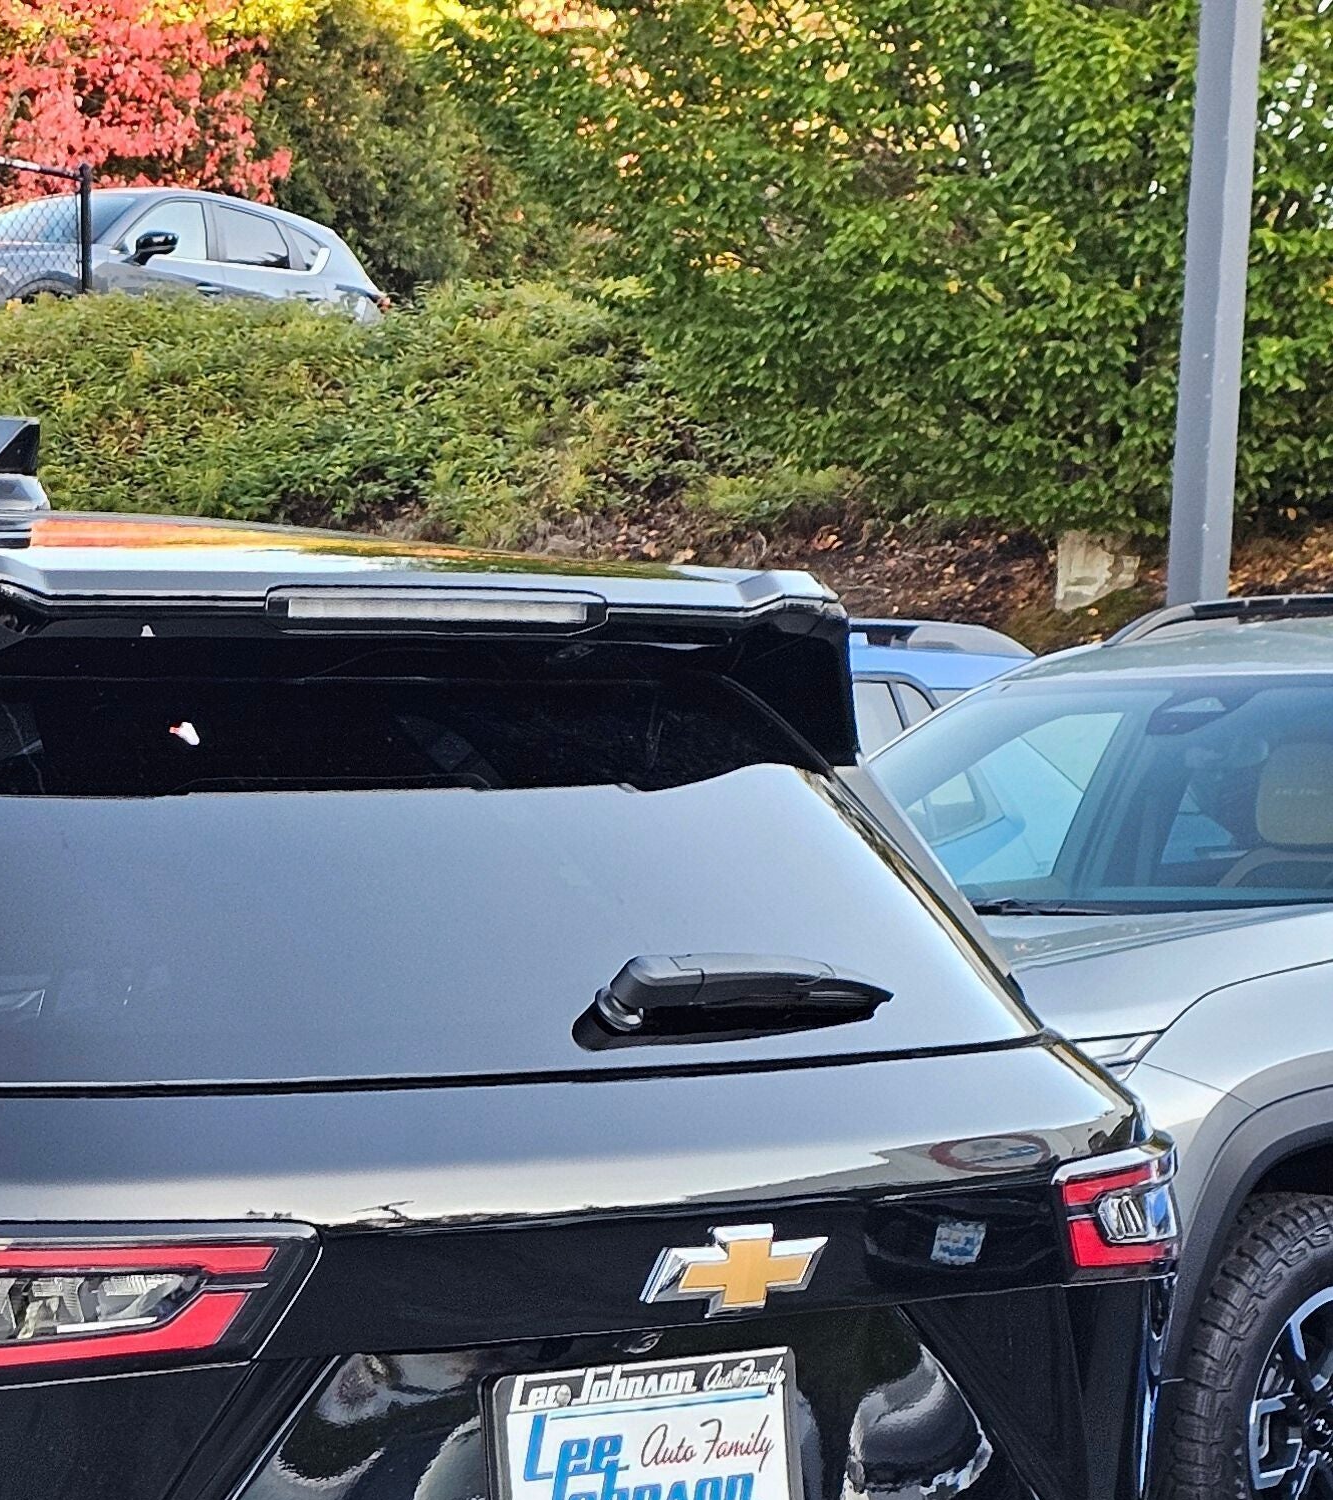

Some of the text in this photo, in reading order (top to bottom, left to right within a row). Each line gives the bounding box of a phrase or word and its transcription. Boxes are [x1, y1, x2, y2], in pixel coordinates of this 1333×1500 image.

[571, 1364, 698, 1406] Johnson
[703, 1362, 743, 1392] Aut
[740, 1356, 787, 1395] Family
[523, 1413, 629, 1482] Lee
[641, 1413, 775, 1472] Auto Family
